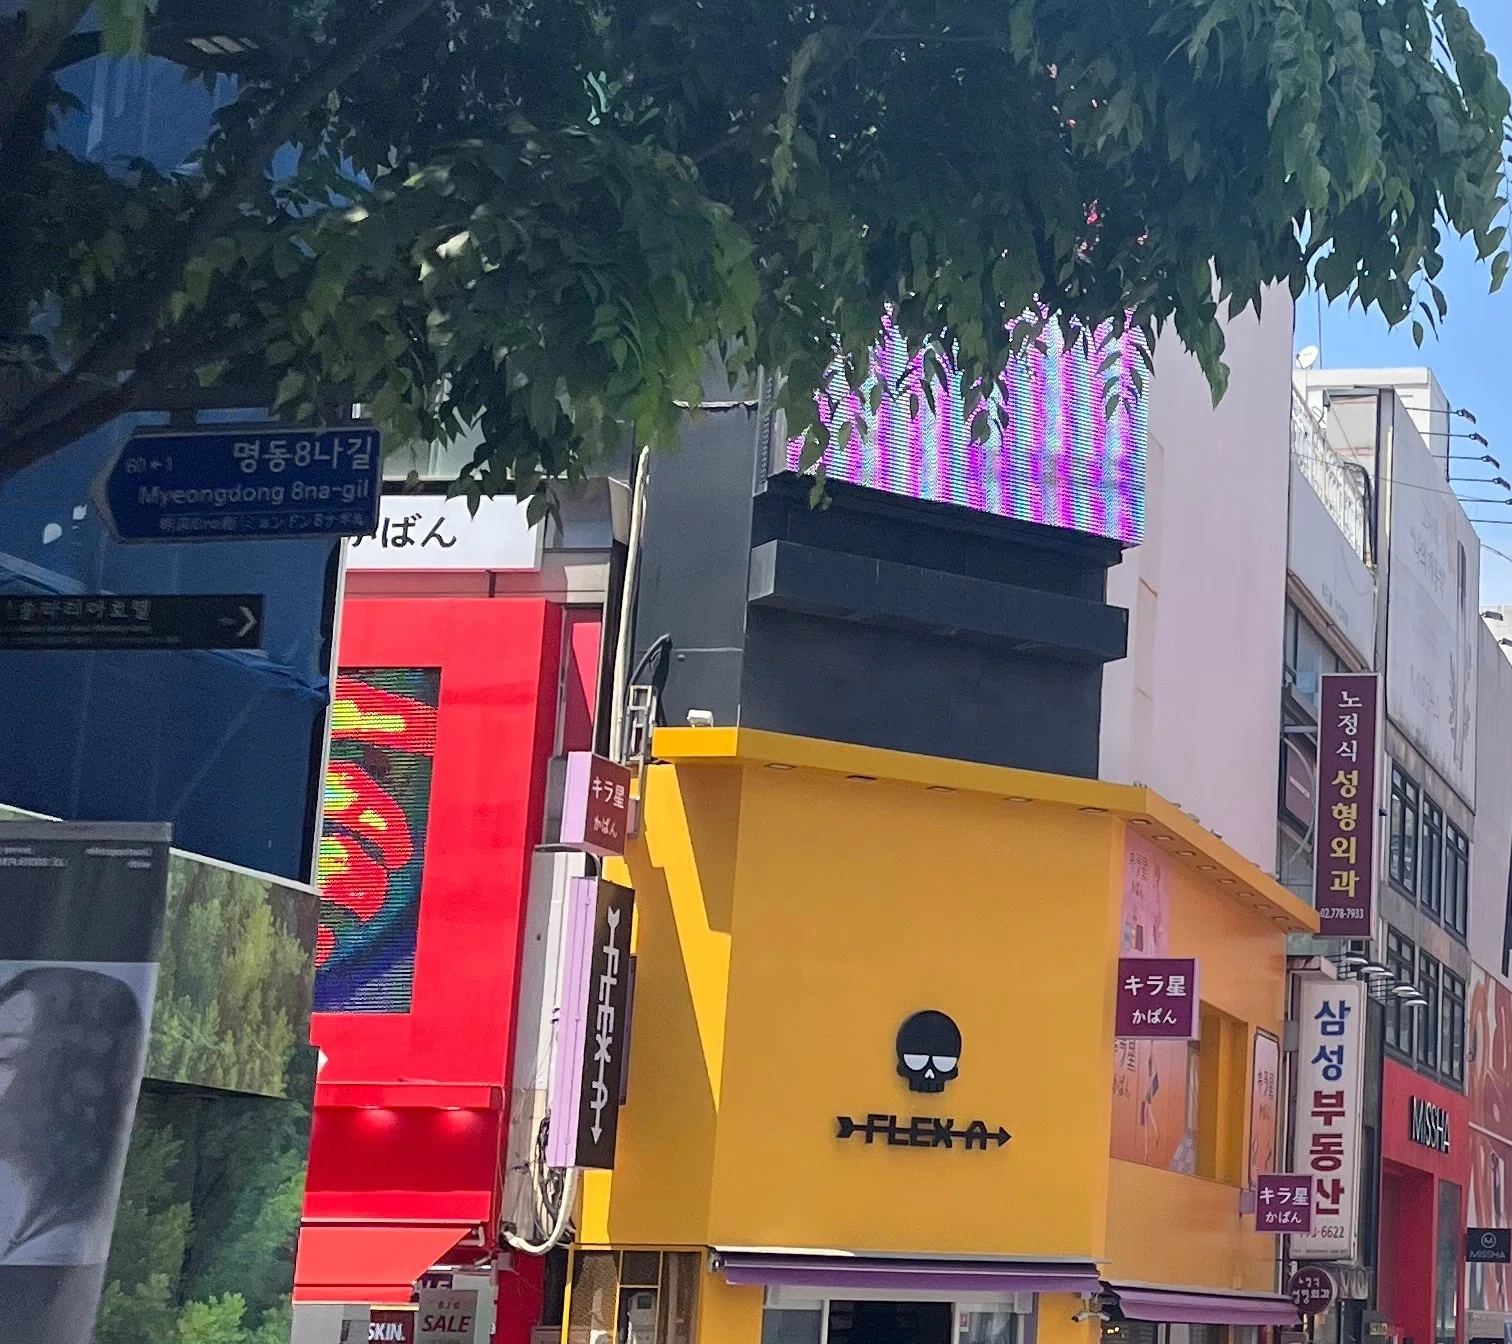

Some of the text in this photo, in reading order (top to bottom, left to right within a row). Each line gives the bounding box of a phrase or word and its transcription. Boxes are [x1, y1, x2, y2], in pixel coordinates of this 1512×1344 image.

[233, 436, 372, 474] 명동8나길
[138, 479, 369, 506] Myeongdong 8na-gil
[352, 513, 457, 548] ばん
[592, 775, 625, 810] キラ星
[1330, 690, 1363, 898] 노정식 성형외과
[592, 814, 618, 839] かばん
[1124, 974, 1187, 998] キラ星
[1131, 1007, 1178, 1026] かばん
[1409, 1095, 1450, 1154] MISSHA
[1259, 1186, 1309, 1207] キラ星
[1265, 1210, 1302, 1224] かばん
[1469, 1249, 1506, 1259] MISSHA
[421, 1314, 472, 1333] SALE
